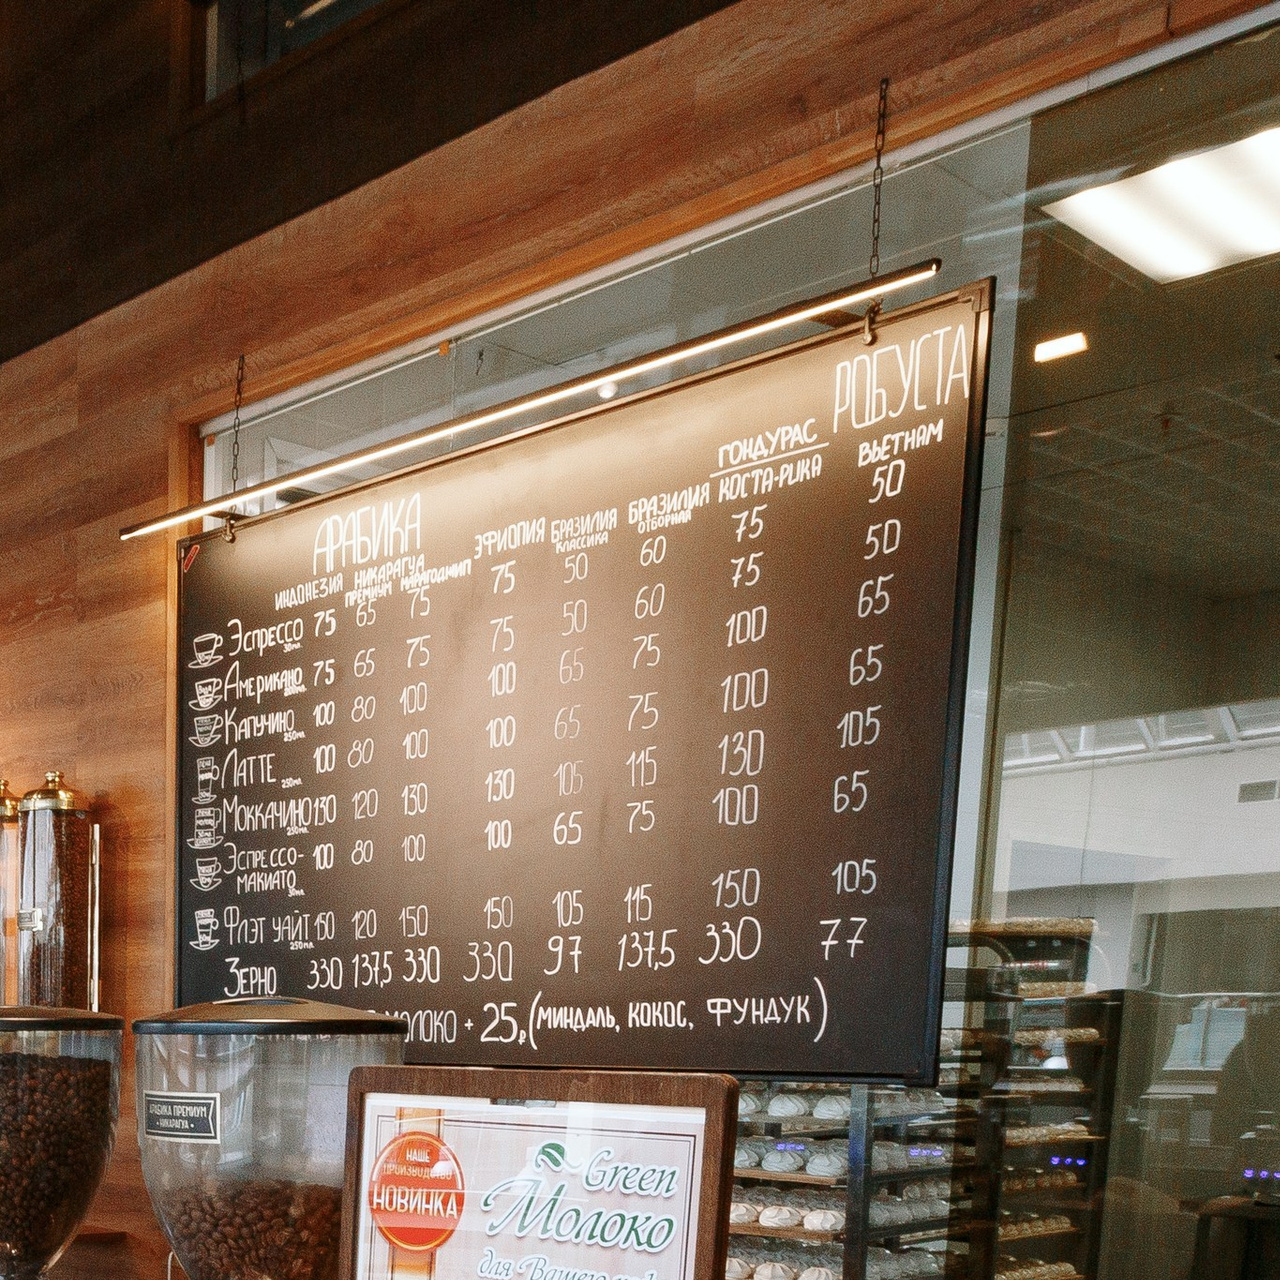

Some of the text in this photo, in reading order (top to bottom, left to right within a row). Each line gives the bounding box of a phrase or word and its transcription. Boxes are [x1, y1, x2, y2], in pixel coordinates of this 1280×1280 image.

[833, 324, 970, 434] РОБУСТА
[718, 418, 818, 468] ГОНДУРАС
[858, 418, 945, 468] ВЬЕТНАМ
[628, 482, 710, 525] БРАЗИЛИЯ
[719, 454, 823, 504] КОСТА-РИКА
[313, 492, 421, 575] АРАБИКА
[473, 516, 546, 560] ЭФИОПИЯ
[550, 508, 618, 543] БРАЗИЛИЯ
[556, 531, 609, 554] КЛАССИКА
[637, 509, 692, 534] ОТБОРНАЯ
[313, 608, 336, 638] 75
[356, 598, 377, 627] 65
[407, 585, 431, 619] 75
[490, 560, 516, 594] 75
[564, 552, 588, 584] 50
[640, 535, 667, 566] 60
[731, 504, 768, 542] 75
[869, 459, 906, 503] 50
[354, 553, 425, 589] НИКАРАГУА
[274, 573, 343, 611] ИНДОНЕЗИЯ
[313, 658, 336, 687] 75
[353, 647, 376, 678] 65
[406, 635, 431, 669] 75
[489, 615, 515, 653] 75
[561, 599, 588, 636] 50
[634, 583, 666, 620] 60
[730, 551, 765, 588] 75
[863, 519, 901, 561] 50
[345, 581, 393, 608] ПРЕМИУМ
[225, 573, 895, 745] КАПУЧИНО 100 80 100 100 65 75 100 65
[221, 644, 884, 789] ЛАТТЕ 100 80 100 100 65 75 100 65
[223, 705, 883, 834] МОККАЧИНО 130 120 130 130 105 115 130 105
[312, 843, 335, 871] 100
[351, 840, 374, 865] 80
[401, 833, 425, 863] 100
[484, 818, 512, 851] 100
[552, 810, 583, 846] 65
[626, 799, 655, 834] 75
[712, 784, 759, 826] 100
[833, 769, 870, 814] 65
[223, 858, 876, 945] ФЛЭТ УАЙТ 150 120 150 150 105 115 150 105
[237, 869, 296, 895] МАКИАТО
[224, 916, 868, 997] ЗЕРНО 330 137,5 330 330 97 137,5 330 77
[628, 998, 694, 1031] КОКОС,
[707, 976, 828, 1043] ФУНДУК)
[173, 1105, 207, 1117] ПРЕМИУМ
[406, 1148, 431, 1162] НАШЕ
[584, 1150, 677, 1194] Green
[373, 1183, 458, 1219] НОВИНКА
[483, 1178, 674, 1249] Молоко
[479, 1249, 512, 1277] для
